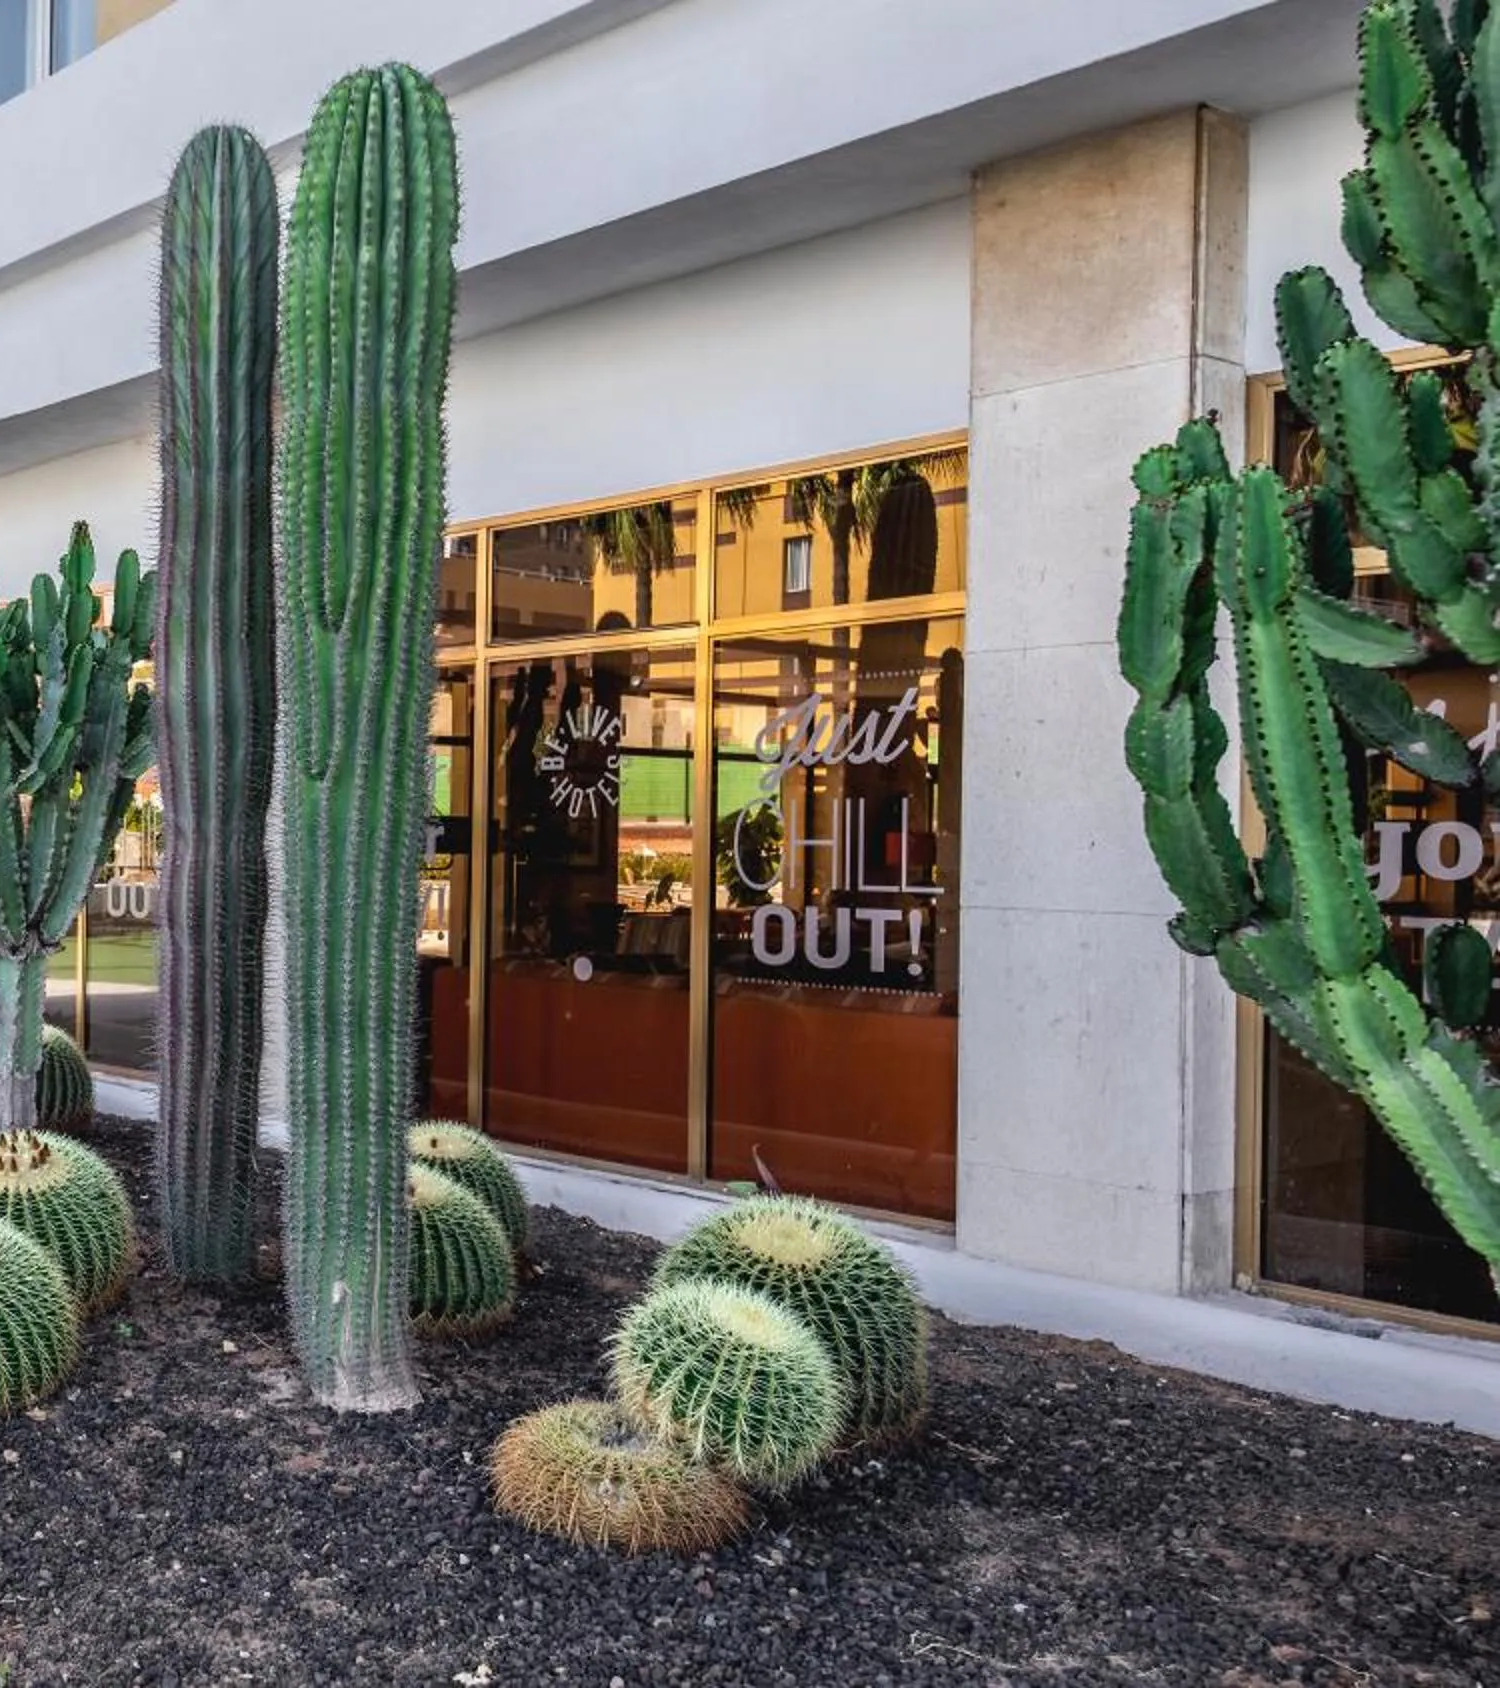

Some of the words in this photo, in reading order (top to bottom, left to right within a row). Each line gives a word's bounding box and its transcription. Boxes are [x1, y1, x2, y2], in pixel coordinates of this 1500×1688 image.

[540, 733, 569, 771] BE
[565, 705, 622, 747] LIVE
[756, 687, 919, 792] Just
[549, 754, 629, 819] HOTELS
[733, 797, 945, 894] CHILL
[752, 903, 924, 978] OUT!
